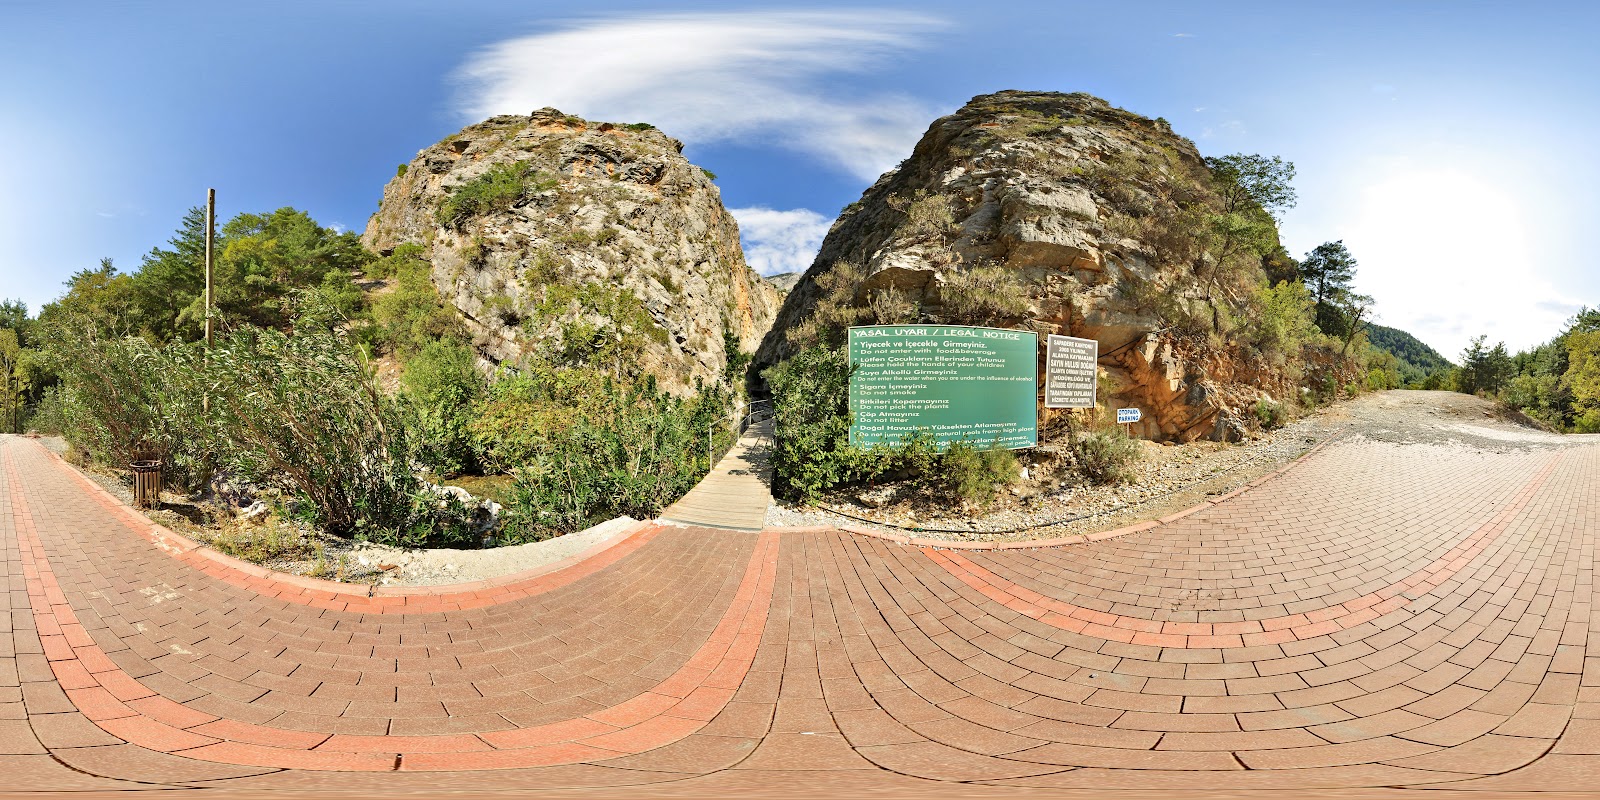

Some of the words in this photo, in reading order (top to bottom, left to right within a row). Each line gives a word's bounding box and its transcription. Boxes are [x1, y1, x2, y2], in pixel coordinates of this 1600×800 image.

[984, 331, 1020, 340] NOTICE
[860, 341, 891, 349] Yiyecek
[906, 339, 938, 348] İçecekle
[943, 341, 987, 349] Girmeyiniz.
[1051, 359, 1063, 367] SAYIN
